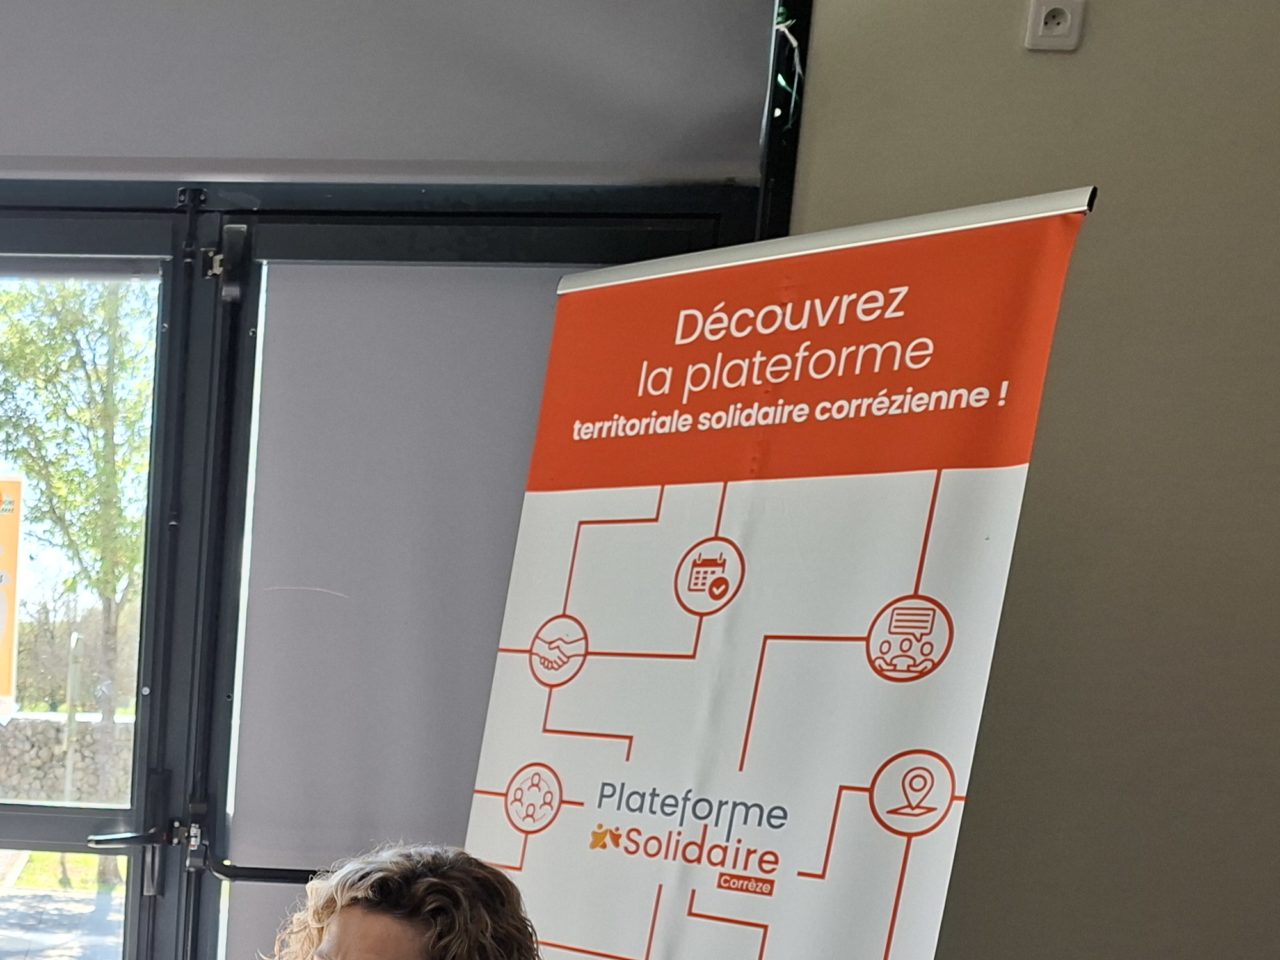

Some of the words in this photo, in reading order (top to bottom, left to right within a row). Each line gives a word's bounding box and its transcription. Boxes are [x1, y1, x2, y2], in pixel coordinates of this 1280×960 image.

[675, 286, 909, 345] Découvrez
[637, 360, 672, 397] la
[682, 336, 934, 404] plateforme
[573, 409, 692, 440] territoriale
[697, 397, 809, 431] solidaire
[814, 383, 989, 422] corrézienne
[999, 380, 1008, 407] !
[597, 782, 788, 842] Plateforme
[624, 824, 779, 874] Solidaire
[720, 875, 771, 894] Corrèze
